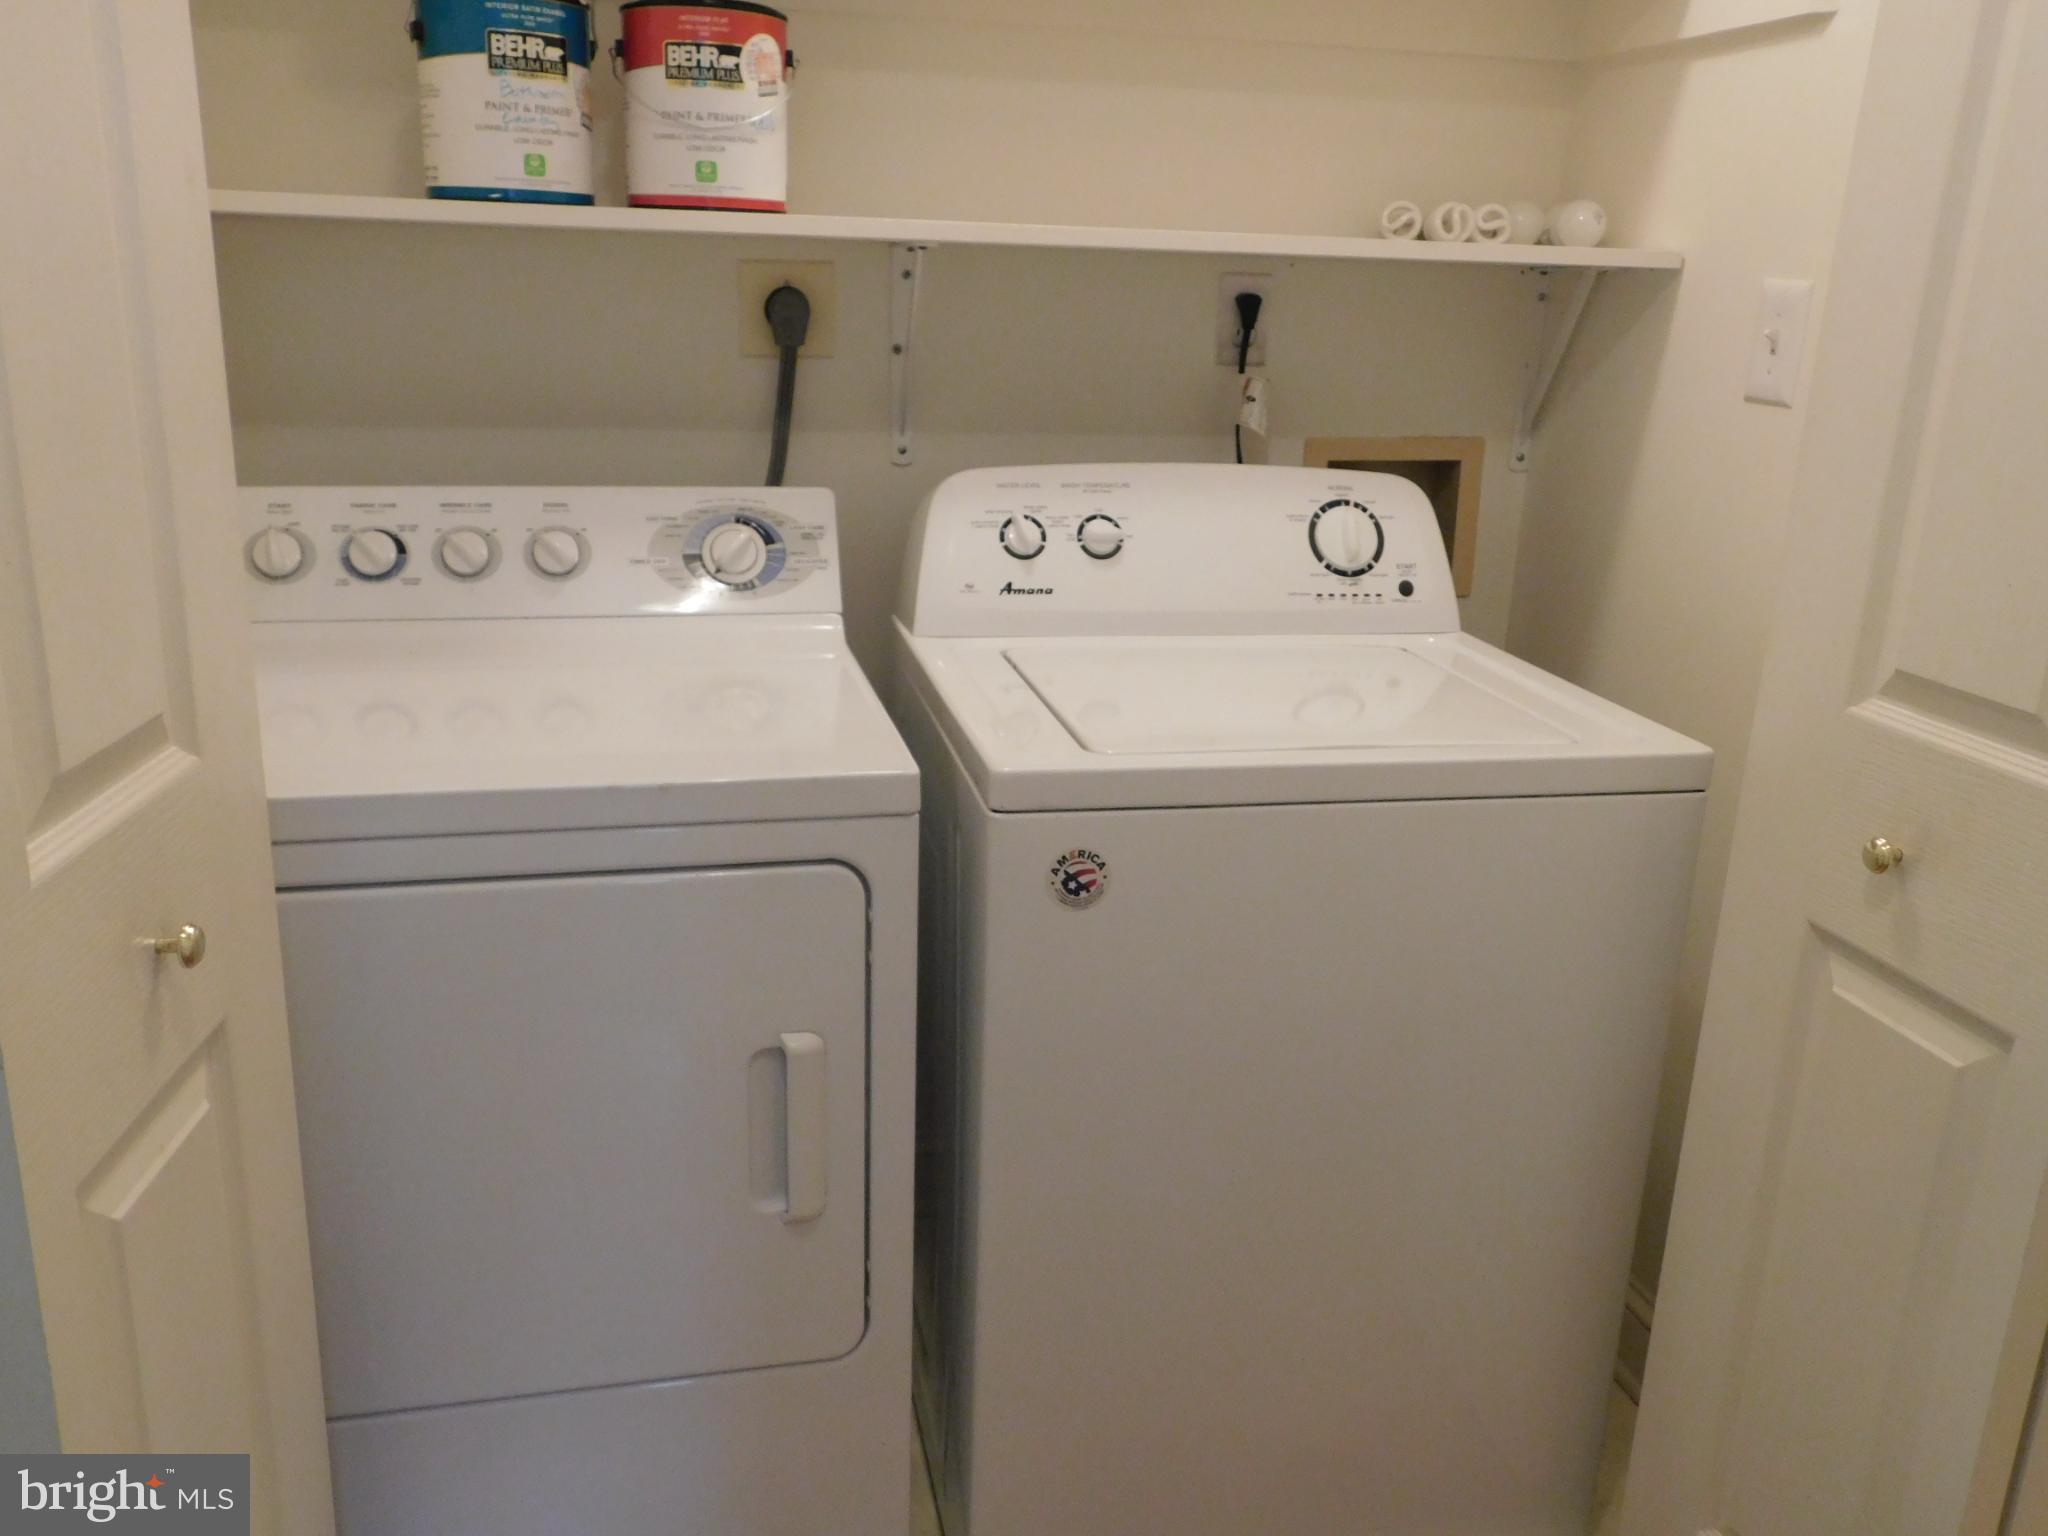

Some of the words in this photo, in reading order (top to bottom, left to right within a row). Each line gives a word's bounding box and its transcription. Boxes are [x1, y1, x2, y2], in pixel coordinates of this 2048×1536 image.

[490, 33, 544, 60] BEHR
[667, 45, 719, 67] BEHR
[490, 56, 541, 72] PREMIUM
[542, 61, 565, 74] PLUS
[667, 66, 714, 80] PREMIUM
[716, 69, 741, 82] PLUS
[484, 100, 519, 112] PAINT
[1000, 582, 1054, 596] Amana
